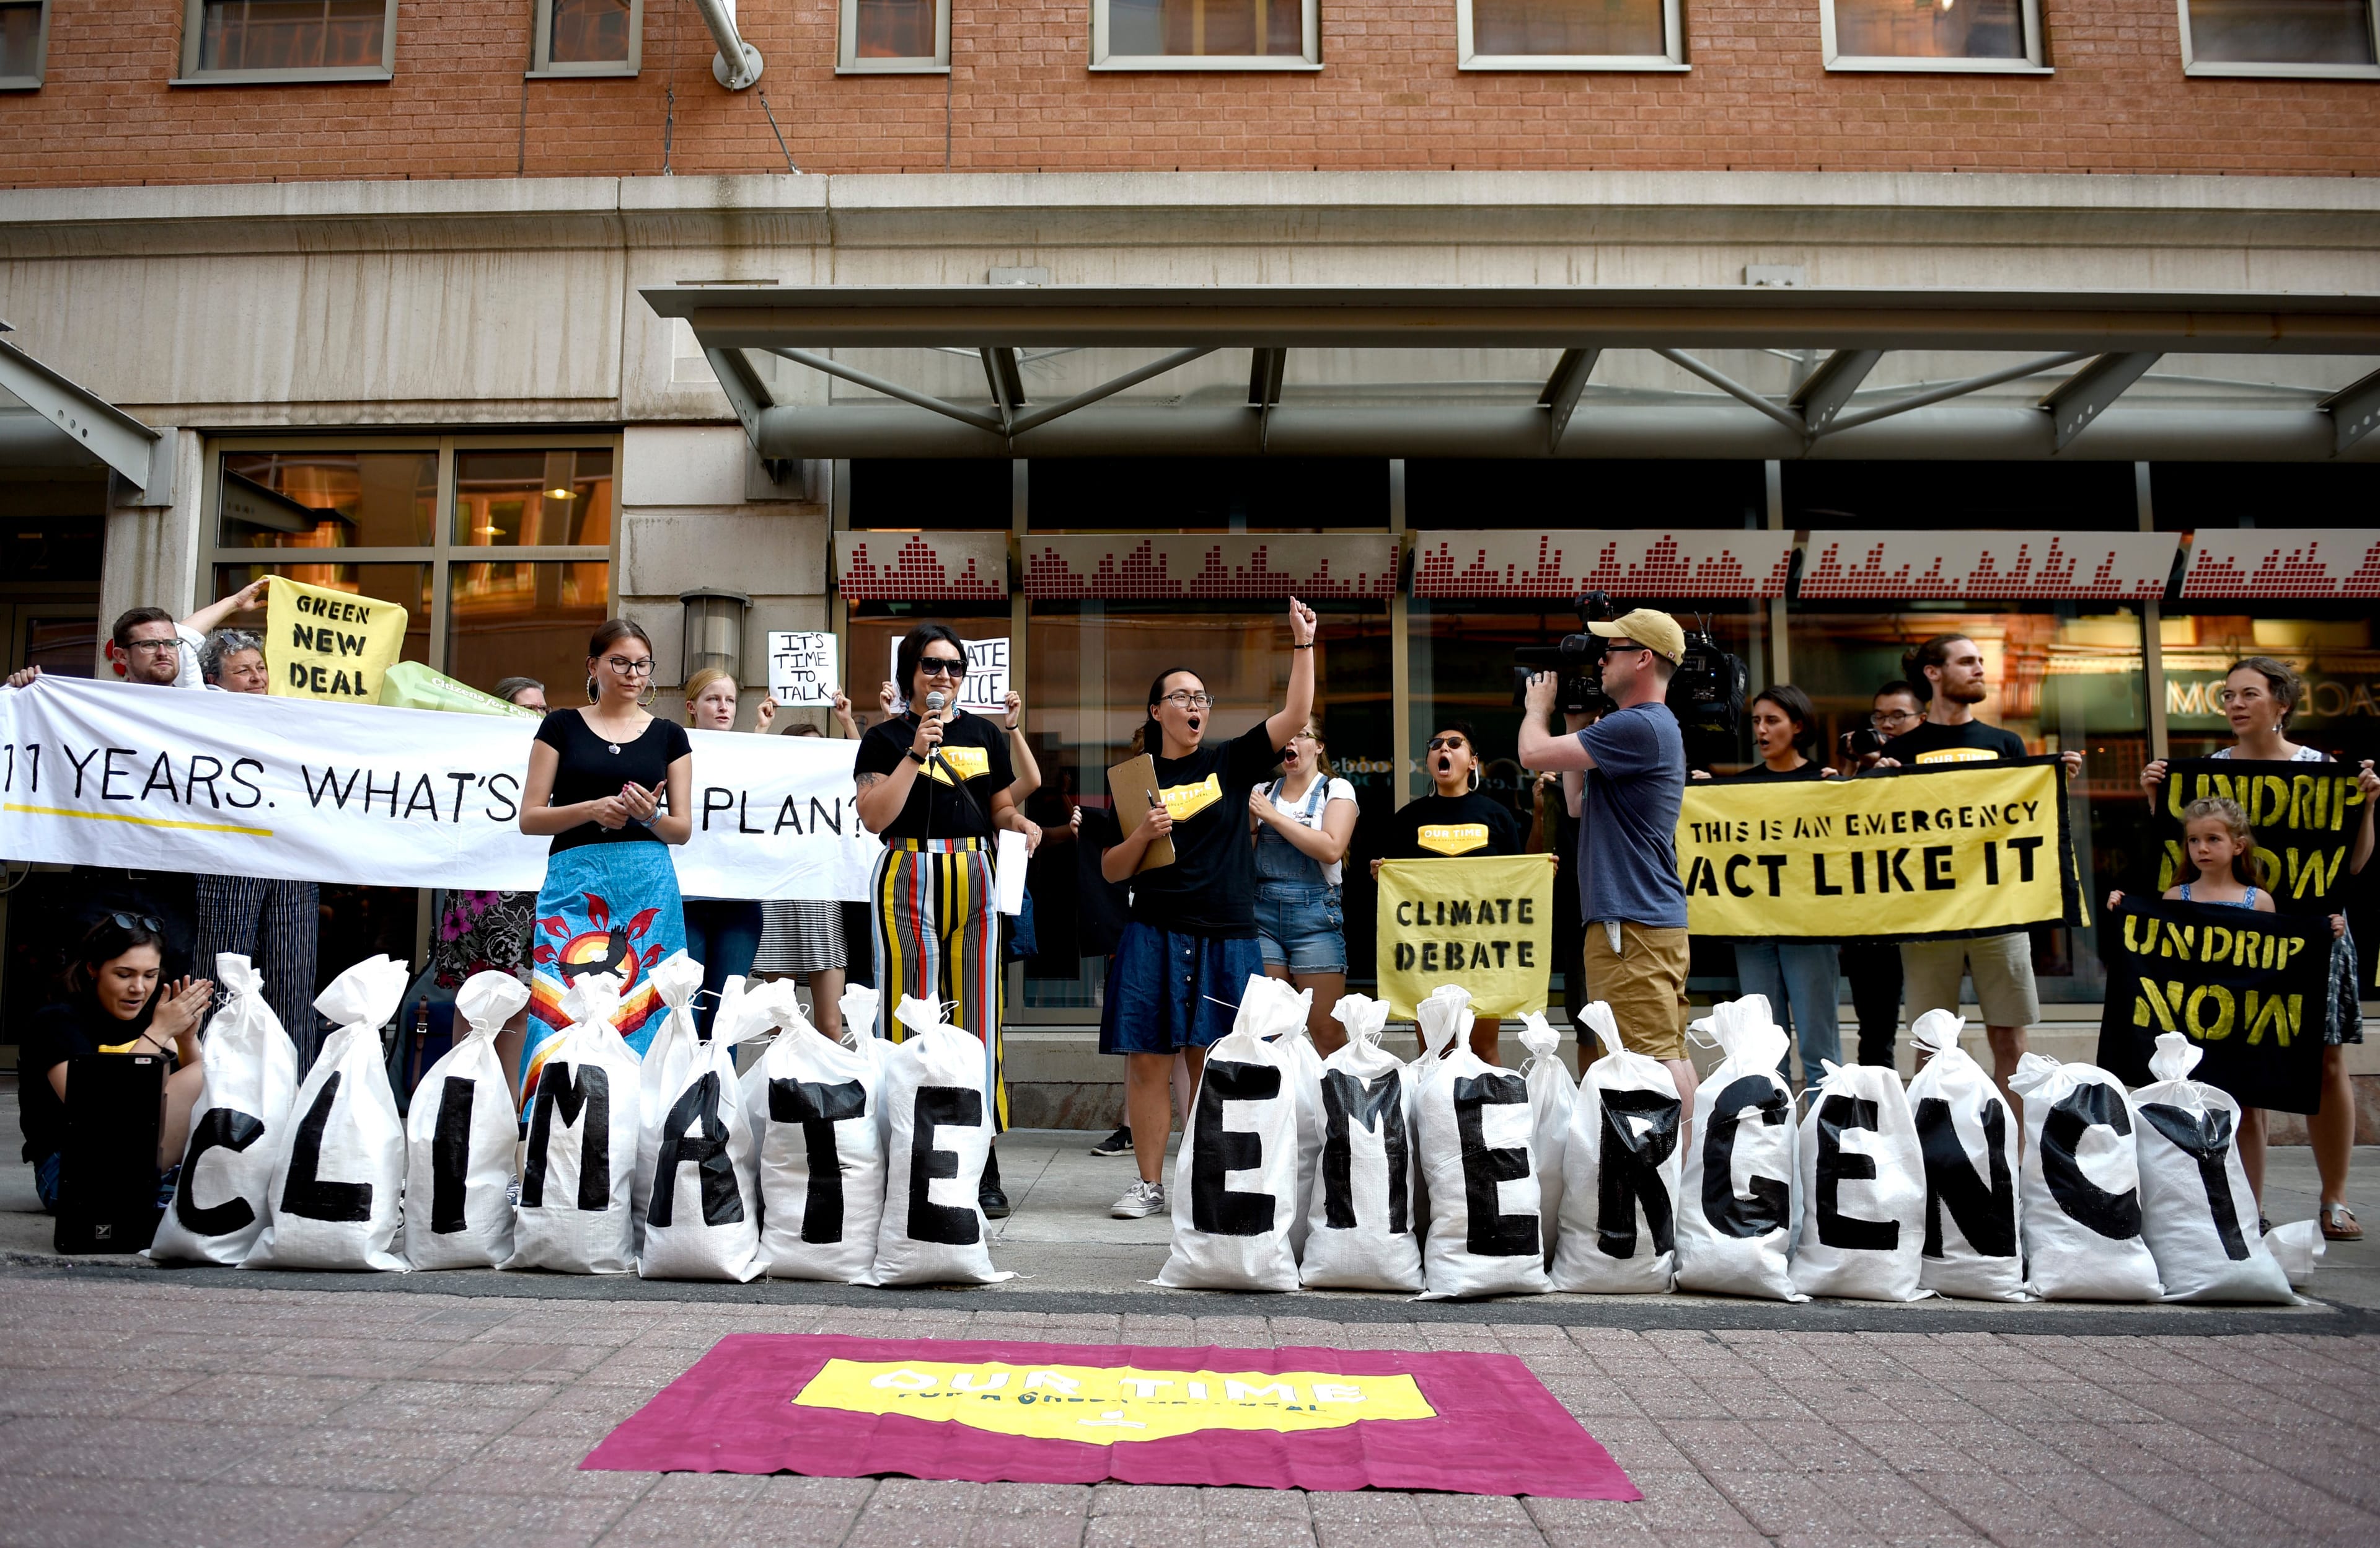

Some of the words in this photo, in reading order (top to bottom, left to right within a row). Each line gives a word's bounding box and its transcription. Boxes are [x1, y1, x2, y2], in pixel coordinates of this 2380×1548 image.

[297, 595, 371, 625] GREEN
[293, 623, 367, 657] NEW
[780, 632, 824, 650] IT'S
[774, 651, 829, 669] TIME
[290, 661, 368, 696] DEAL
[777, 682, 831, 701] TALK
[791, 670, 816, 683] TO
[431, 677, 485, 702] Citizens
[483, 697, 507, 710] for
[948, 751, 984, 763] TIME
[1923, 754, 1954, 764] OUR
[1957, 752, 1991, 762] TIME
[4, 743, 40, 793] 11
[63, 743, 275, 809] YEARS.
[301, 764, 519, 823] WHAT'S
[1179, 779, 1213, 801] TIME
[2169, 772, 2367, 831] UNDRIP
[1424, 829, 1450, 838] OUR
[1452, 828, 1483, 838] TIME
[1690, 820, 1749, 844] THIS
[1760, 819, 1783, 841] IS
[1793, 815, 1831, 839] AN
[1846, 800, 2040, 836] EMERGENCY
[1685, 853, 1787, 898] ACT
[1813, 845, 1957, 896] LIKE
[1984, 835, 2044, 886] IT
[1396, 897, 1534, 928] CLIMATE
[1395, 940, 1535, 971] DEBATE
[2123, 914, 2306, 971] UNDRIP
[2133, 976, 2303, 1048] NOW
[176, 1061, 982, 1246] CLIMATE
[1190, 1059, 2251, 1262] EMERGENCY
[869, 1369, 1081, 1395] OUR
[1118, 1379, 1368, 1403] TIME
